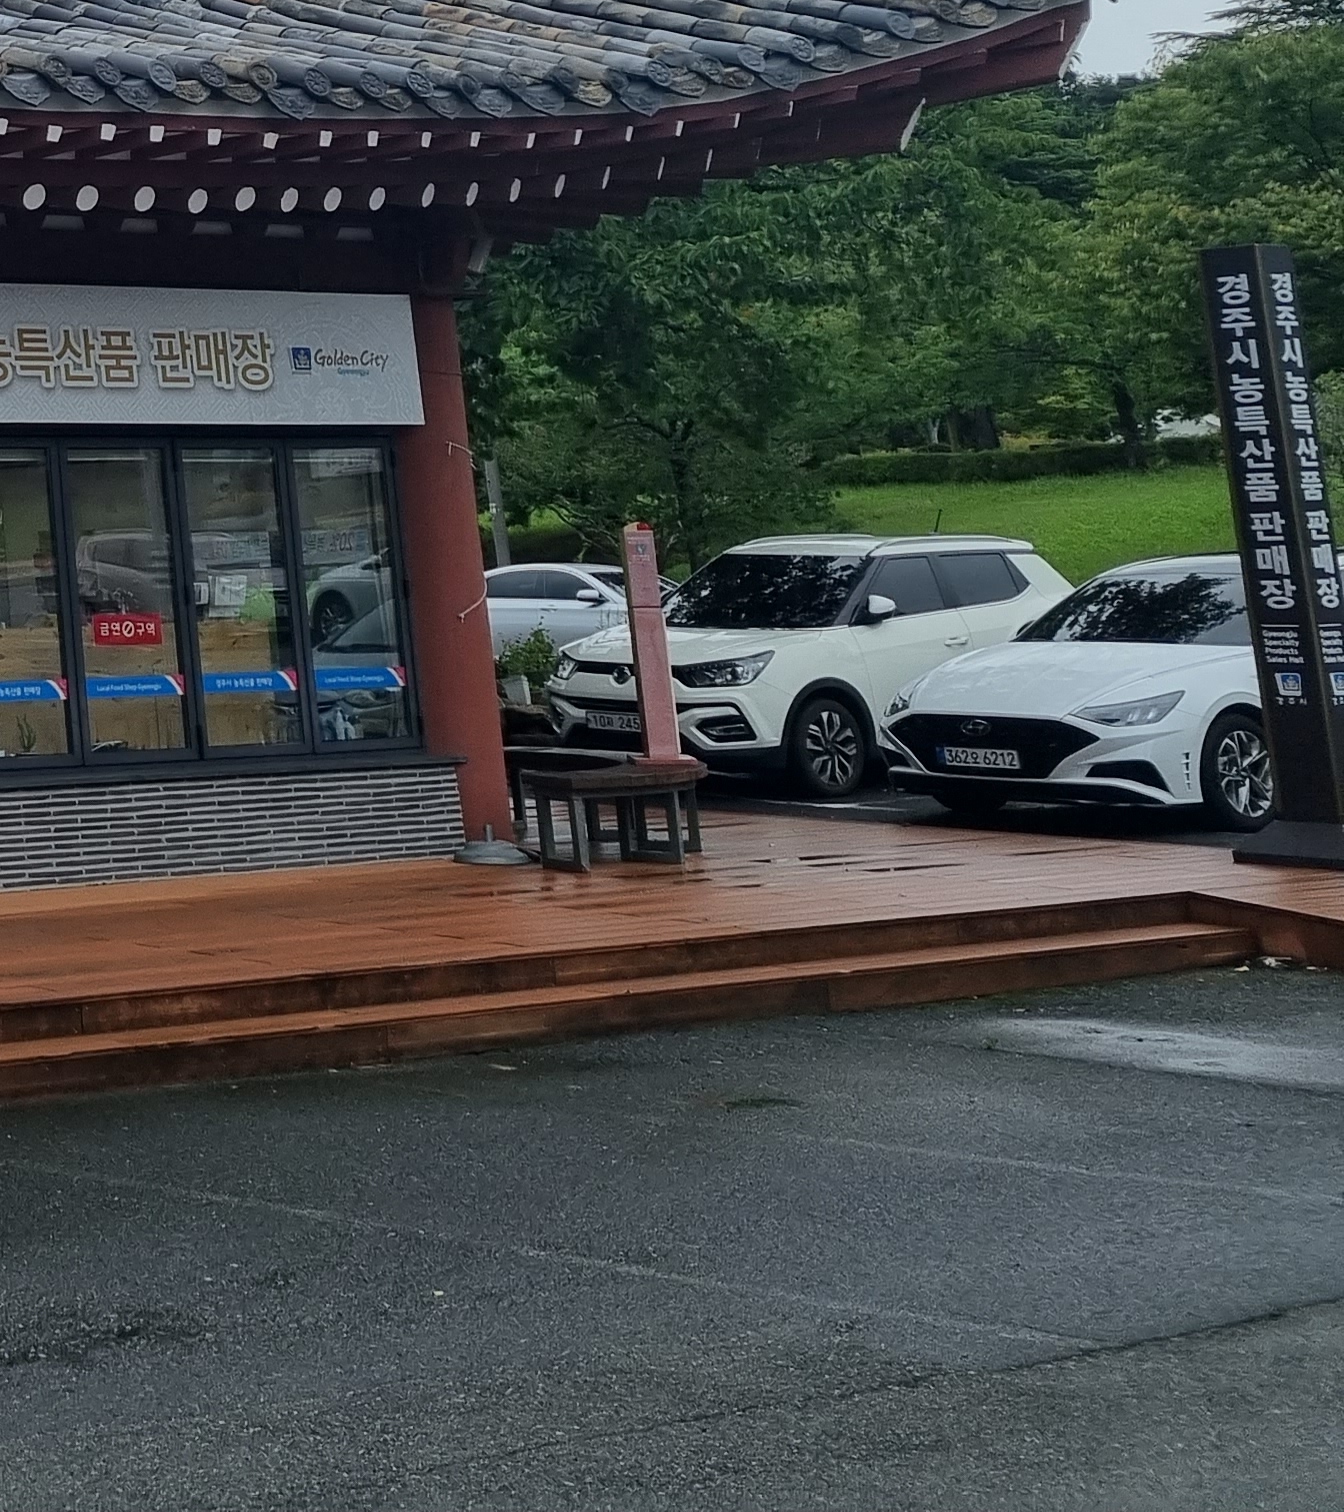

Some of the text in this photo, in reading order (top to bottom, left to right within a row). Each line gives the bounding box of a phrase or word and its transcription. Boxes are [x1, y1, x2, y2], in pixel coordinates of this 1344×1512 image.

[151, 328, 273, 389] 판매장
[313, 348, 389, 372] Golden City
[1216, 272, 1297, 610] 경주시 농특산품 판매장
[1269, 272, 1341, 609] 경주시 농특산품 판매장
[99, 622, 156, 637] 금연 구역
[617, 716, 641, 730] 245
[945, 748, 1018, 767] 362오 6212
